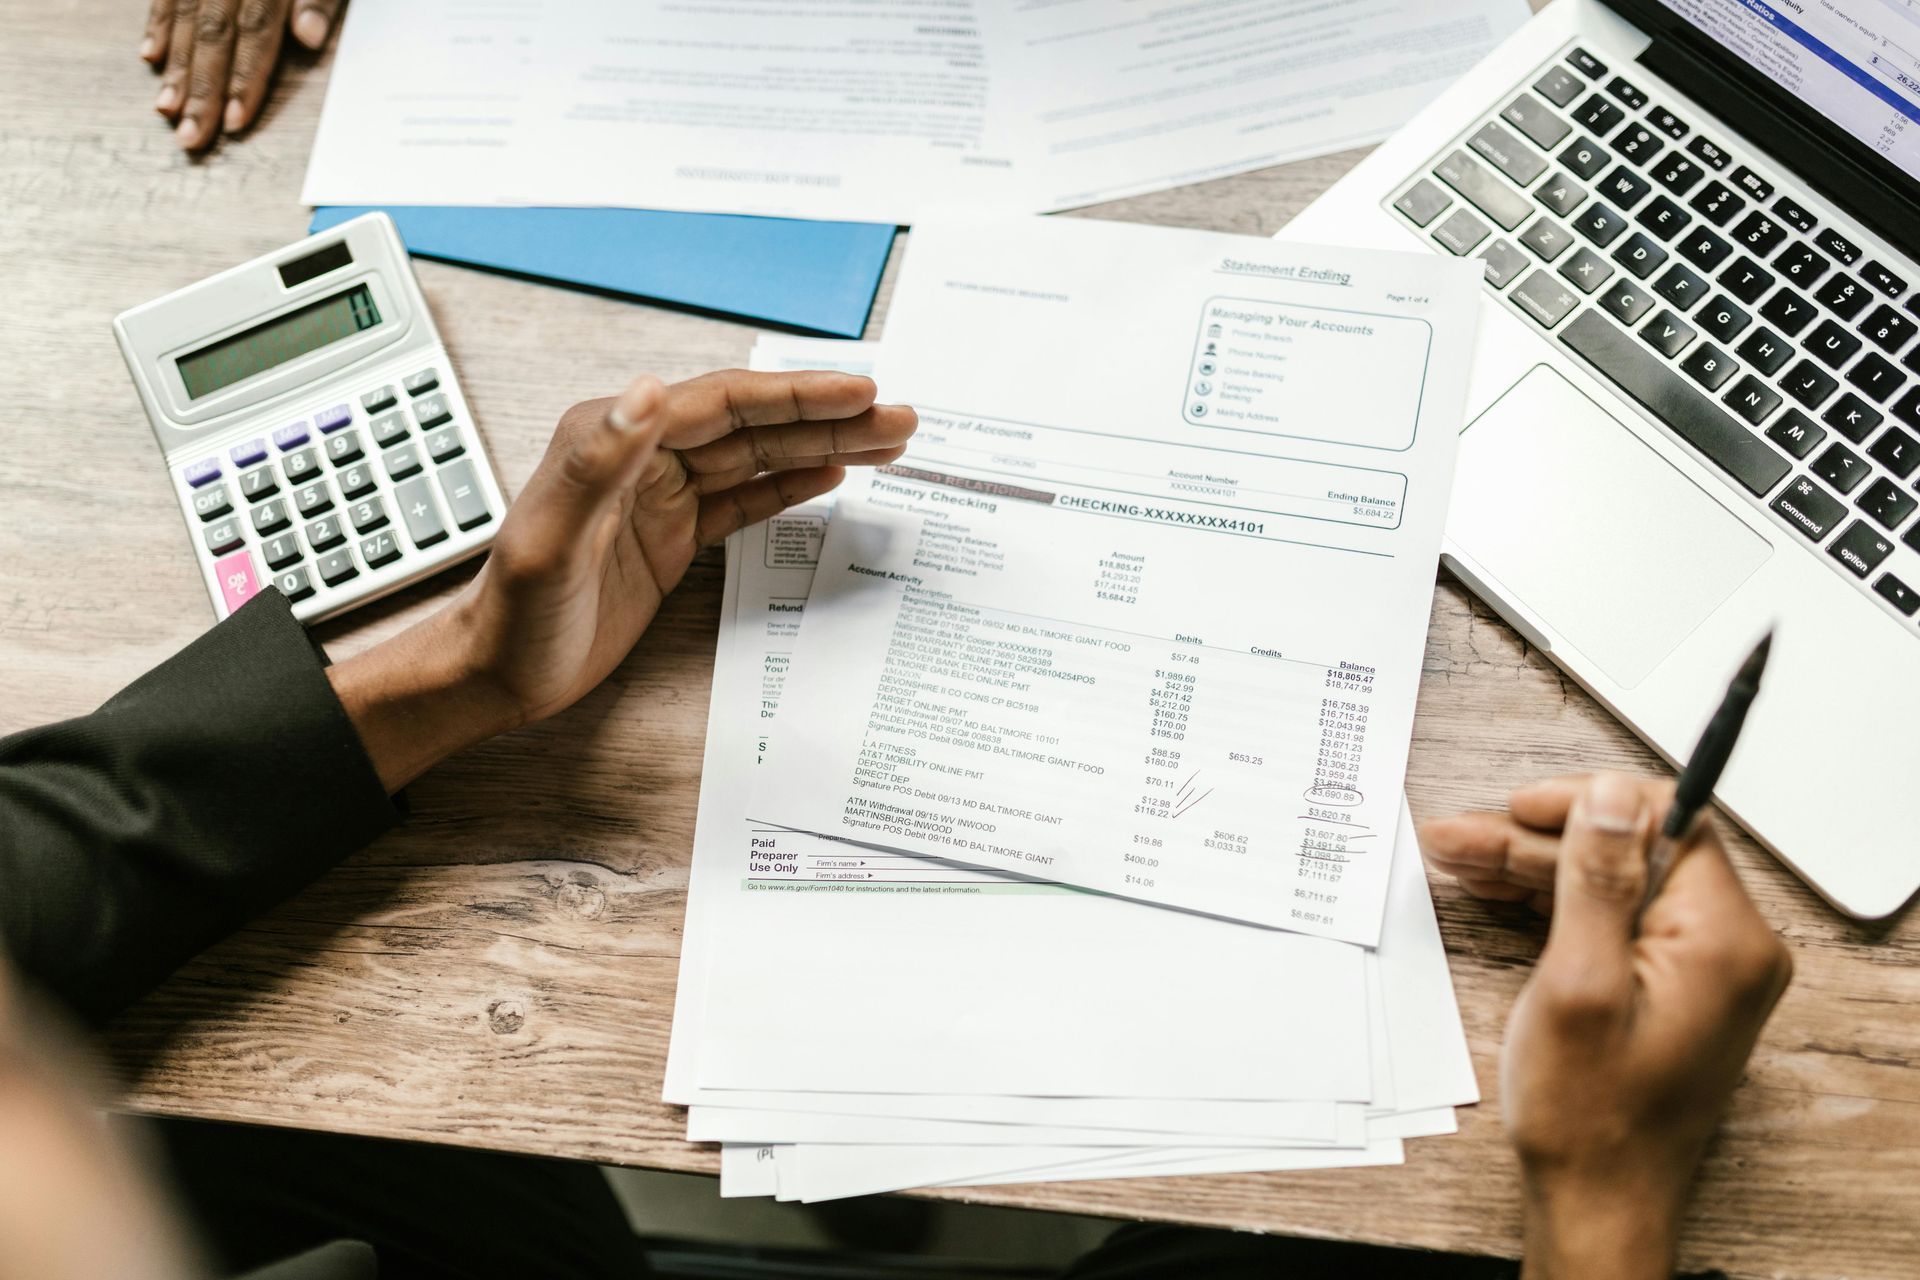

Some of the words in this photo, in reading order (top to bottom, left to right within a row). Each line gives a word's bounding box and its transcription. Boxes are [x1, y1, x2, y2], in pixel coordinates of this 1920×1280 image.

[1859, 25, 1878, 41] equity
[1578, 150, 1592, 164] Q
[1616, 178, 1634, 193] W
[1552, 186, 1567, 201] A
[1658, 210, 1671, 222] E
[1594, 218, 1607, 229] S
[1539, 232, 1554, 245] Z
[1633, 247, 1647, 260] D
[1698, 241, 1711, 254] R
[1221, 259, 1296, 277] Statement
[1296, 267, 1352, 285] Ending
[1579, 262, 1595, 276] X
[1675, 280, 1689, 289] F
[1742, 272, 1754, 283] T
[1621, 295, 1635, 307] C
[1784, 304, 1797, 315] Y
[1210, 307, 1274, 325] Managing
[1276, 315, 1308, 327] Your
[1310, 319, 1375, 335] Accounts
[1717, 312, 1731, 324] G
[1663, 326, 1676, 338] V
[1826, 336, 1840, 349] U
[1758, 343, 1774, 357] H
[1704, 359, 1716, 371] B
[1803, 379, 1815, 388] J
[1872, 372, 1882, 381] I
[1745, 392, 1761, 406] N
[1846, 410, 1861, 424] K
[1788, 426, 1805, 441] M
[333, 436, 348, 454] 9
[1893, 445, 1902, 458] L
[291, 454, 306, 471] 8
[247, 471, 260, 489] 7
[346, 469, 360, 486] 6
[1168, 470, 1204, 481] Account
[1203, 474, 1238, 485] Number
[196, 490, 222, 509] OFF
[303, 487, 317, 505] 5
[870, 479, 927, 499] Primary
[929, 489, 998, 512] Checking
[1327, 490, 1359, 503] Ending
[1360, 495, 1396, 506] Balance
[260, 505, 274, 521] 4
[358, 503, 372, 521] 3
[1353, 507, 1394, 519] $5,684.22
[1780, 500, 1823, 534] command
[213, 526, 232, 541] CE
[315, 522, 330, 540] 2
[272, 540, 283, 556] 1
[1876, 542, 1887, 552] alt
[1112, 551, 1145, 562] Amount
[1840, 547, 1868, 572] option
[848, 563, 888, 577] Account
[886, 570, 923, 586] Activity
[283, 574, 298, 591] 0
[902, 593, 946, 609] Beginning
[945, 602, 981, 614] Balance
[1175, 633, 1203, 644] Debits
[1250, 646, 1282, 657] Credits
[888, 648, 934, 663] DISCOVER
[934, 657, 961, 668] BANK
[960, 662, 1017, 679] ETRANSFER
[1171, 653, 1200, 665] $57.48
[1340, 661, 1376, 673] Balance
[1326, 670, 1374, 684] $18,805.47
[881, 674, 939, 692] DEVONSHIRE
[940, 686, 946, 694] II
[946, 687, 962, 697] CO
[962, 690, 991, 703] CONS
[989, 696, 1005, 705] CP
[1005, 699, 1039, 712] BC5198
[1165, 681, 1194, 693] $42.99
[876, 693, 912, 706] TARGET
[912, 700, 947, 713] ONLINE
[947, 706, 968, 717] PMT
[1148, 698, 1191, 712] $8,212.00
[1321, 699, 1369, 714] $16,758.39
[1154, 708, 1189, 722] $160.75
[873, 702, 892, 712] ATM
[892, 705, 939, 721] Withdrawal
[938, 714, 964, 726] 09/07
[963, 719, 980, 729] MD
[980, 722, 1034, 740] BALTIMORE
[1034, 733, 1060, 744] 10101
[1318, 718, 1366, 733] $12,043.98
[1150, 728, 1185, 741] $195.00
[877, 742, 917, 756] FITNESS
[860, 748, 884, 760] AT&T
[884, 753, 929, 768] MOBILITY
[928, 762, 963, 775] ONLINE
[964, 768, 984, 779] PMT
[1228, 752, 1263, 766] $653.25
[855, 767, 890, 780] DIRECT
[889, 773, 910, 783] DEP
[1145, 777, 1176, 789] $70.11
[847, 796, 867, 807] ATM
[866, 799, 914, 816] Withdrawal
[914, 809, 939, 821] 09/15
[938, 814, 957, 824] WV
[956, 817, 997, 832] INWOOD
[1134, 805, 1171, 818] $116.22
[1308, 808, 1351, 822] $3,620.78
[844, 806, 953, 834] MARTINSBURG-INWOOD
[751, 839, 775, 848] Paid
[842, 815, 883, 832] Signature
[881, 823, 904, 834] POS
[902, 827, 927, 839] Debit
[926, 832, 952, 844] 09/16
[952, 837, 969, 848] MD
[968, 840, 1024, 858] BALTIMORE
[1024, 851, 1054, 864] GIANT
[1203, 839, 1247, 854] $3,033.33
[750, 851, 798, 861] Preparer
[1124, 854, 1159, 867] $400.00
[750, 863, 771, 872] Use
[774, 864, 798, 873] Only
